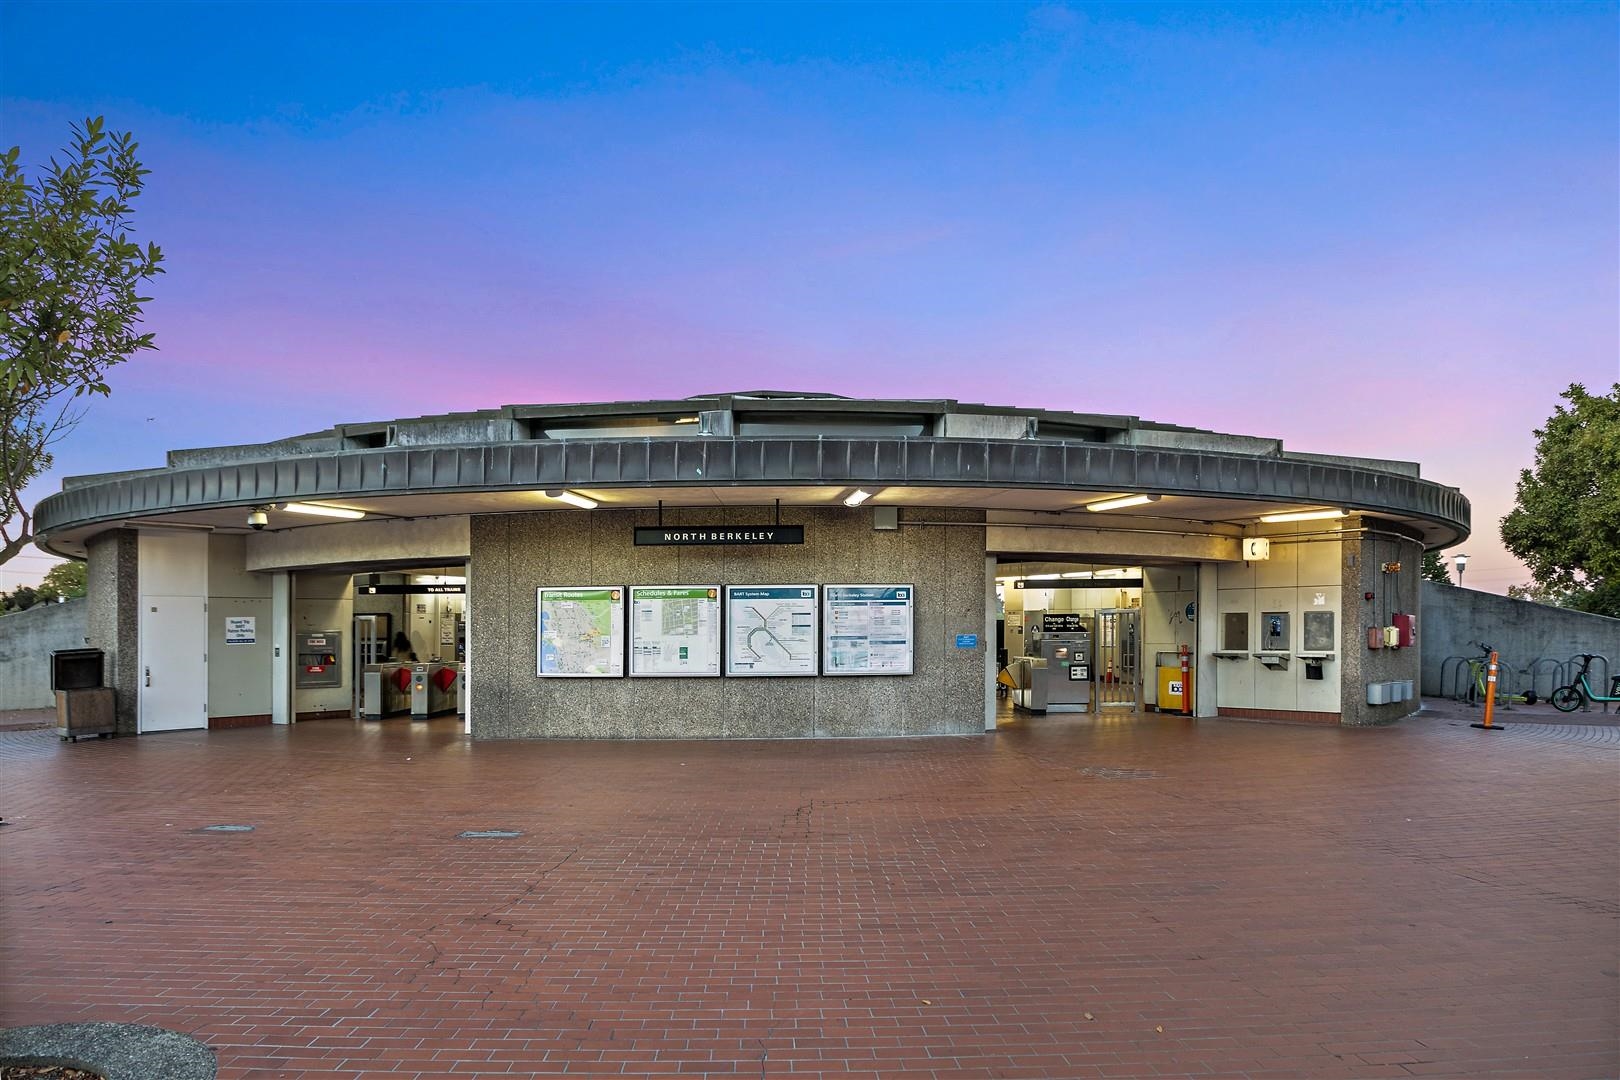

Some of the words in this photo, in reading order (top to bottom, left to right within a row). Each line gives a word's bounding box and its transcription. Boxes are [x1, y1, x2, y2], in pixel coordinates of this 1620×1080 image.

[664, 533, 707, 541] NORTH
[711, 532, 774, 540] BERKELEY
[1044, 616, 1065, 624] Change
